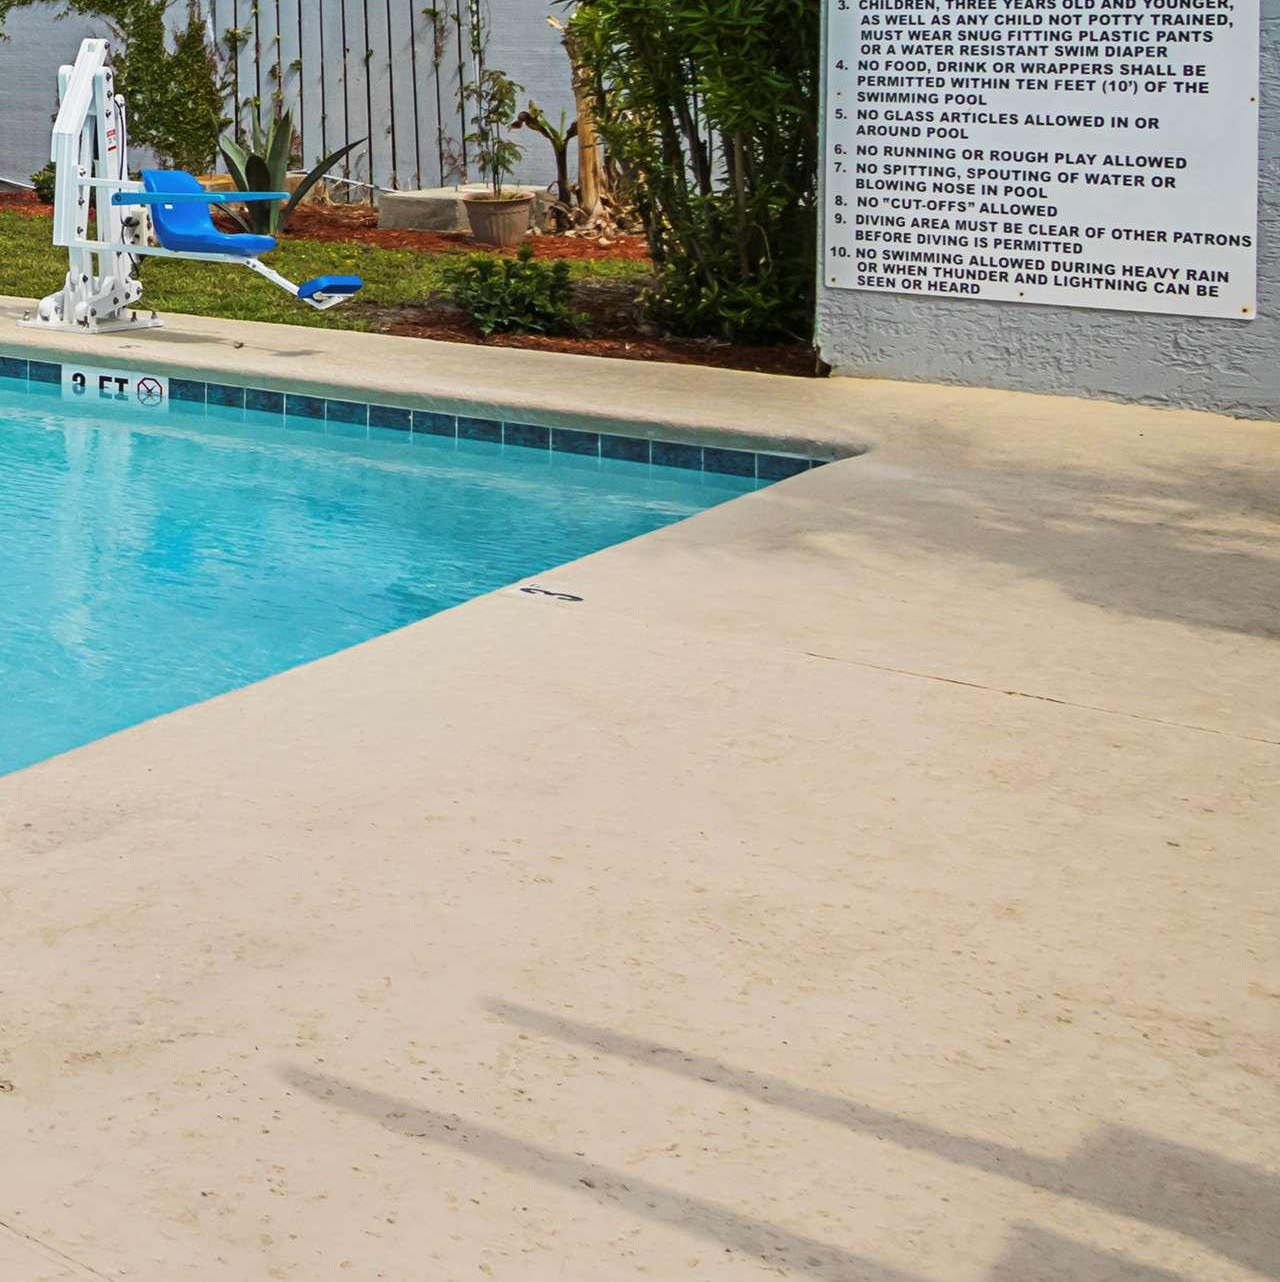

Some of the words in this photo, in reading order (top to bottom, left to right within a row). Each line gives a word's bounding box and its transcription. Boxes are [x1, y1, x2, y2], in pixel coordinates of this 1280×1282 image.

[838, 0, 849, 10] 3.
[859, 0, 939, 12] CHILDREN,
[861, 15, 880, 25] AS
[885, 15, 926, 25] WELL
[931, 15, 950, 25] AS
[956, 14, 989, 25] ANY
[994, 14, 1043, 25] CHILD
[1049, 14, 1083, 25] NOT
[1089, 14, 1144, 25] POTTY
[1150, 14, 1233, 28] TRAINED,
[861, 30, 903, 41] MUST
[908, 30, 952, 41] WEAR
[958, 30, 1002, 41] SNUG
[1008, 30, 1072, 42] FITTING
[1079, 31, 1150, 42] PLASTIC
[1156, 31, 1213, 42] PANTS
[861, 44, 881, 55] OR
[886, 45, 896, 55] A
[901, 44, 954, 56] WATER
[960, 45, 1048, 56] RESISTANT
[1055, 45, 1098, 57] SWIM
[1105, 46, 1168, 57] DIAPER
[835, 60, 848, 70] 4.
[858, 60, 879, 71] NO
[885, 61, 931, 74] FOOD,
[937, 61, 987, 73] DRINK
[993, 62, 1015, 73] OR
[1021, 63, 1113, 75] WRAPPERS
[1120, 64, 1176, 76] SHALL
[1183, 65, 1206, 76] BE
[857, 76, 945, 88] PERMITTED
[951, 78, 1009, 89] WITHIN
[1016, 79, 1048, 90] TEN
[1055, 80, 1096, 91] FEET
[1145, 81, 1167, 92] OF
[1173, 82, 1209, 94] THE
[857, 91, 939, 104] SWIMMING
[945, 94, 987, 105] POOL
[835, 109, 847, 119] 5.
[857, 110, 878, 120] NO
[884, 110, 934, 122] GLASS
[940, 112, 1018, 125] ARTICLES
[1024, 114, 1104, 127] ALLOWED
[1111, 117, 1128, 128] IN
[1135, 117, 1159, 129] OR
[856, 125, 921, 137] AROUND
[927, 127, 968, 139] POOL
[834, 144, 846, 154] 6.
[857, 145, 878, 156] NO
[884, 146, 956, 159] RUNNING
[962, 149, 984, 160] OR
[990, 150, 1048, 163] ROUGH
[1055, 153, 1097, 165] PLAY
[1103, 155, 1187, 169] ALLOWED
[834, 162, 846, 172] 7.
[856, 163, 877, 174] NO
[883, 164, 961, 180] SPITTING,
[967, 168, 1051, 182] SPOUTING
[1058, 172, 1079, 183] OF
[1085, 173, 1145, 187] WATER
[1151, 176, 1176, 188] OR
[856, 178, 926, 192] BLOWING
[933, 182, 975, 195] NOSE
[982, 185, 998, 196] IN
[1004, 186, 1048, 198] POOL
[835, 195, 847, 206] 8.
[857, 196, 878, 208] NO
[979, 203, 1057, 217] ALLOWED
[835, 213, 846, 224] 9.
[856, 214, 905, 227] DIVING
[911, 217, 950, 230] AREA
[956, 220, 998, 232] MUST
[1004, 222, 1023, 234] BE
[1029, 224, 1079, 237] CLEAR
[1085, 227, 1106, 238] OF
[1111, 229, 1167, 242] OTHER
[1173, 232, 1251, 247] PATRONS
[855, 230, 911, 243] BEFORE
[917, 234, 968, 247] DIVING
[974, 237, 988, 248] IS
[994, 238, 1082, 254] PERMITTED
[830, 246, 851, 257] 10.
[856, 248, 877, 259] NO
[882, 250, 963, 265] SWIMMING
[969, 255, 1045, 270] ALLOWED
[1051, 261, 1115, 275] DURING
[1122, 265, 1180, 279] HEAVY
[1186, 269, 1229, 283] RAIN
[857, 262, 877, 273] OR
[883, 263, 927, 276] WHEN
[933, 267, 1009, 283] THUNDER
[1014, 273, 1048, 285] AND
[1054, 275, 1147, 292] LIGHTNING
[1154, 282, 1189, 295] CAN
[1197, 285, 1219, 297] BE
[857, 275, 895, 288] SEEN
[901, 279, 922, 290] OR
[928, 280, 980, 294] HEARD
